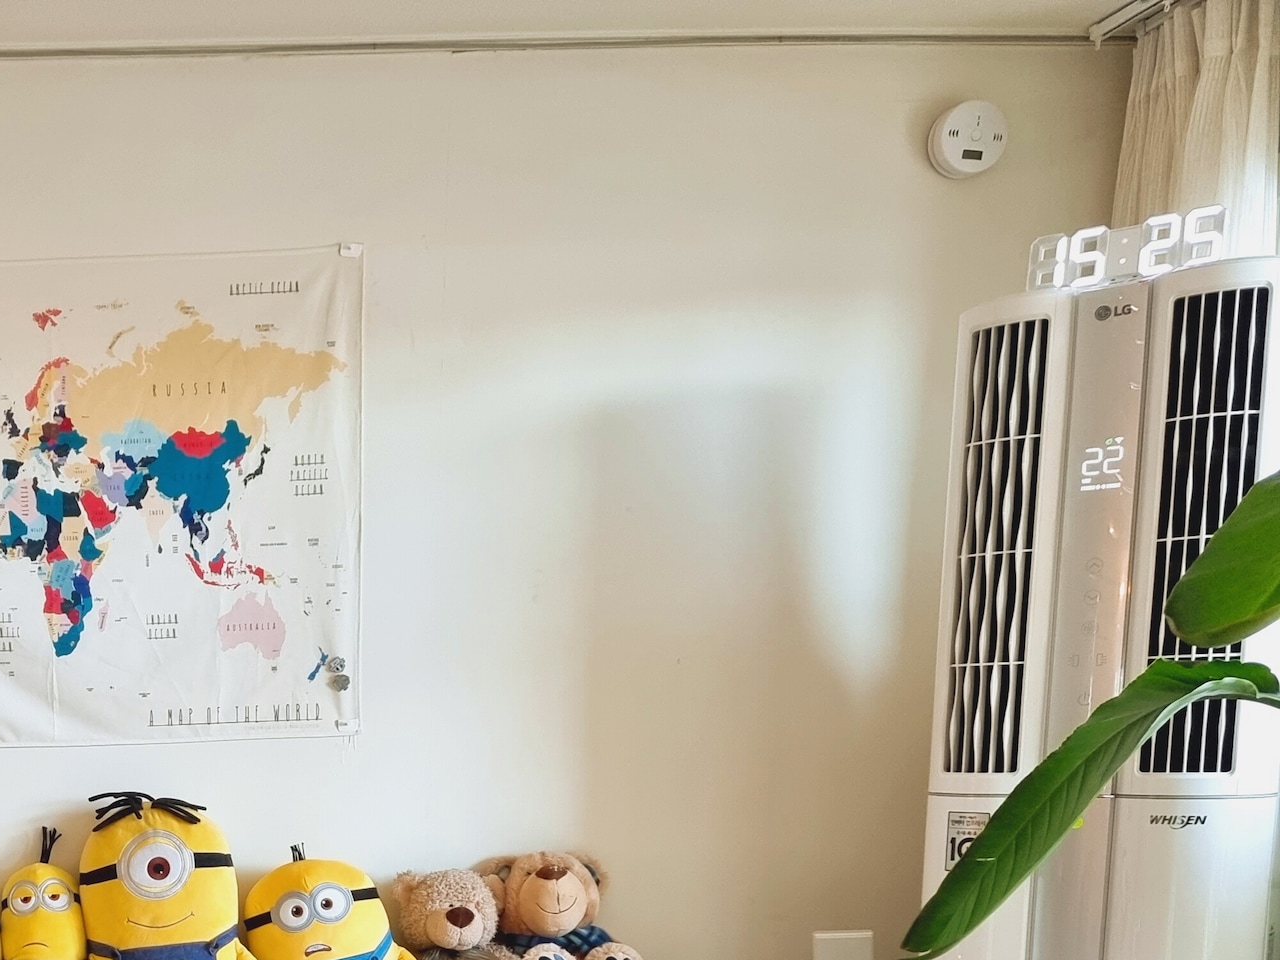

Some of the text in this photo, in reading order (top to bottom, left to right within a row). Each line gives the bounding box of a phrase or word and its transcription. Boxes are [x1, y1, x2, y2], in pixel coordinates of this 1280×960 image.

[1052, 205, 1228, 289] 15:25
[270, 280, 300, 294] OCEAN
[152, 380, 228, 397] RUSSIA
[293, 453, 325, 465] NORTH
[1081, 445, 1124, 476] 22
[293, 484, 325, 497] OCEAN
[147, 628, 177, 640] OCEAN
[226, 622, 277, 632] AUSTRALIA
[148, 702, 322, 726] A MAP OF THE WORLD
[1148, 814, 1208, 830] WHISEN
